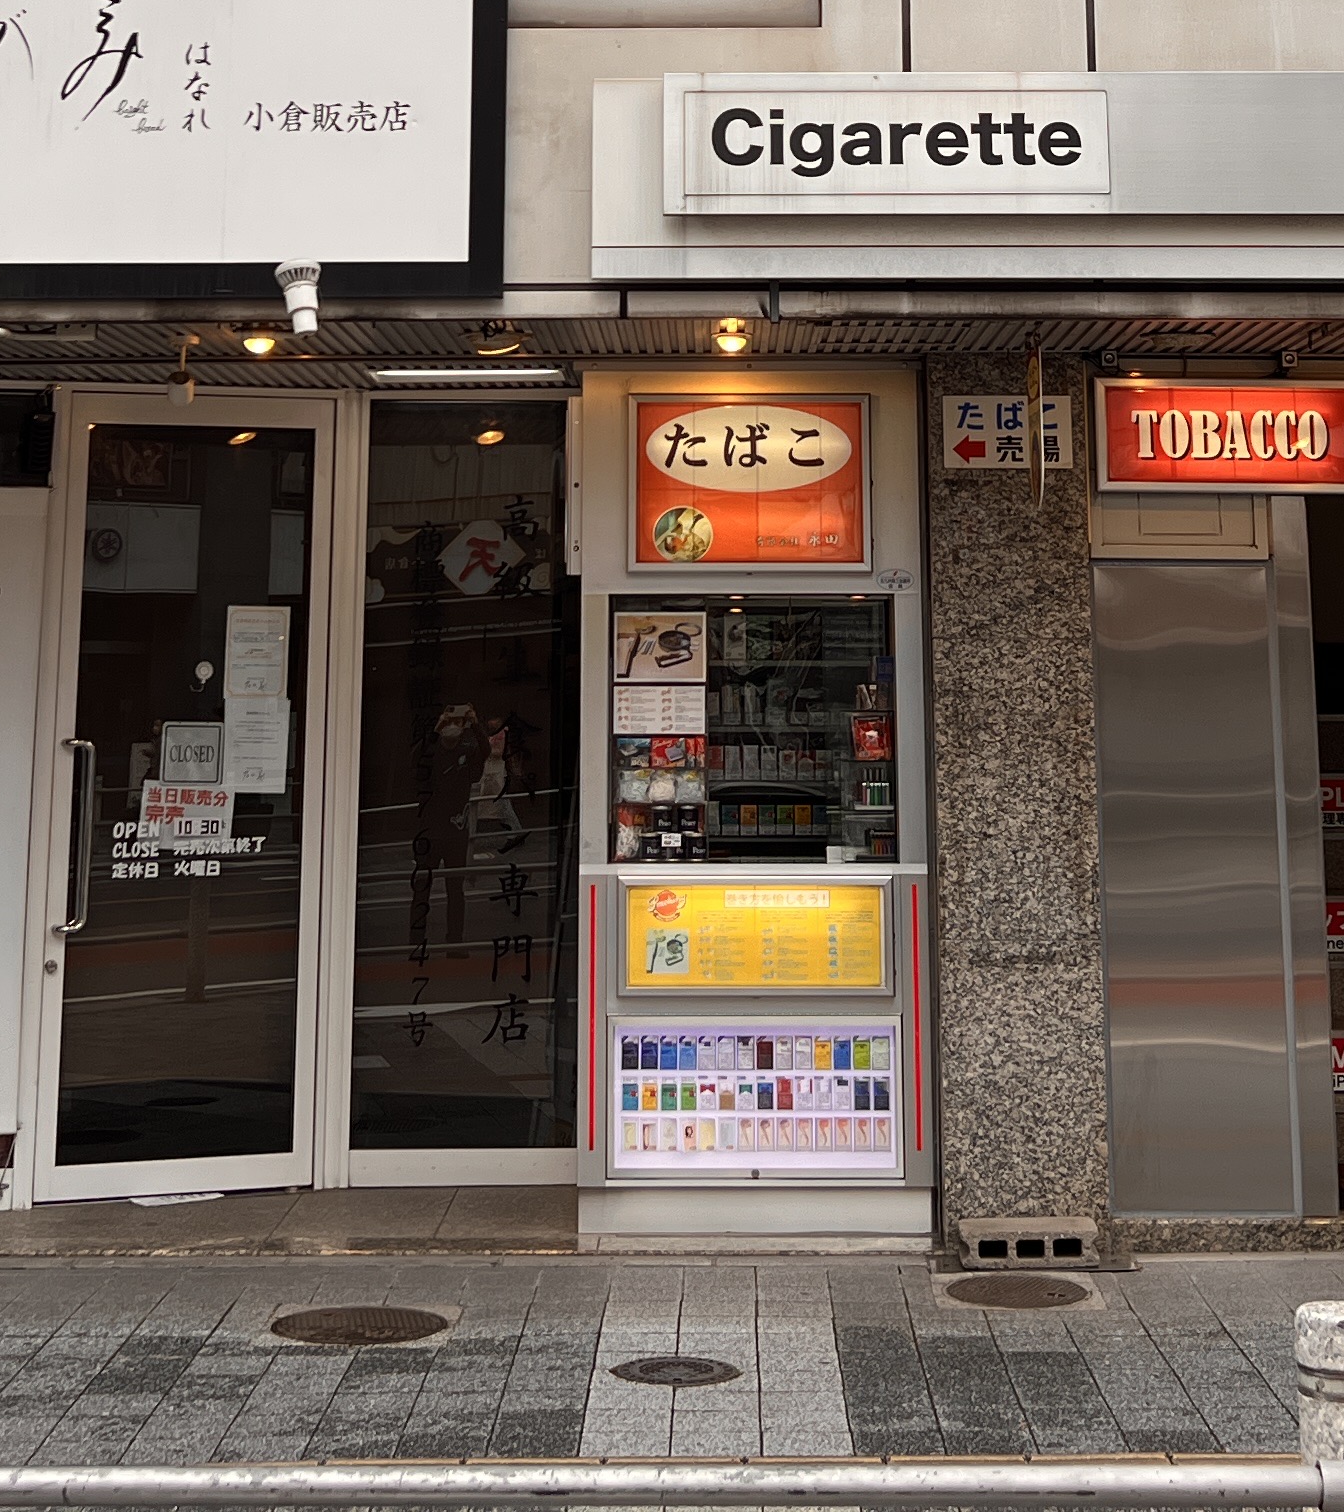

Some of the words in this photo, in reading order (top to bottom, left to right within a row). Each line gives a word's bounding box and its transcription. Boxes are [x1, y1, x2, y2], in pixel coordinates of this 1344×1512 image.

[182, 42, 211, 133] はなれ
[244, 101, 412, 133] 小倉販売店
[711, 107, 1082, 177] Cigarette
[664, 422, 825, 468] たばこ
[1131, 409, 1330, 461] TOBACCO
[169, 743, 215, 764] CLOSED
[147, 788, 229, 807] 当日販売分
[112, 821, 160, 839] OPEN
[112, 841, 160, 859] CLOSE
[112, 862, 159, 879] 定休日
[174, 860, 221, 877] 火曜日
